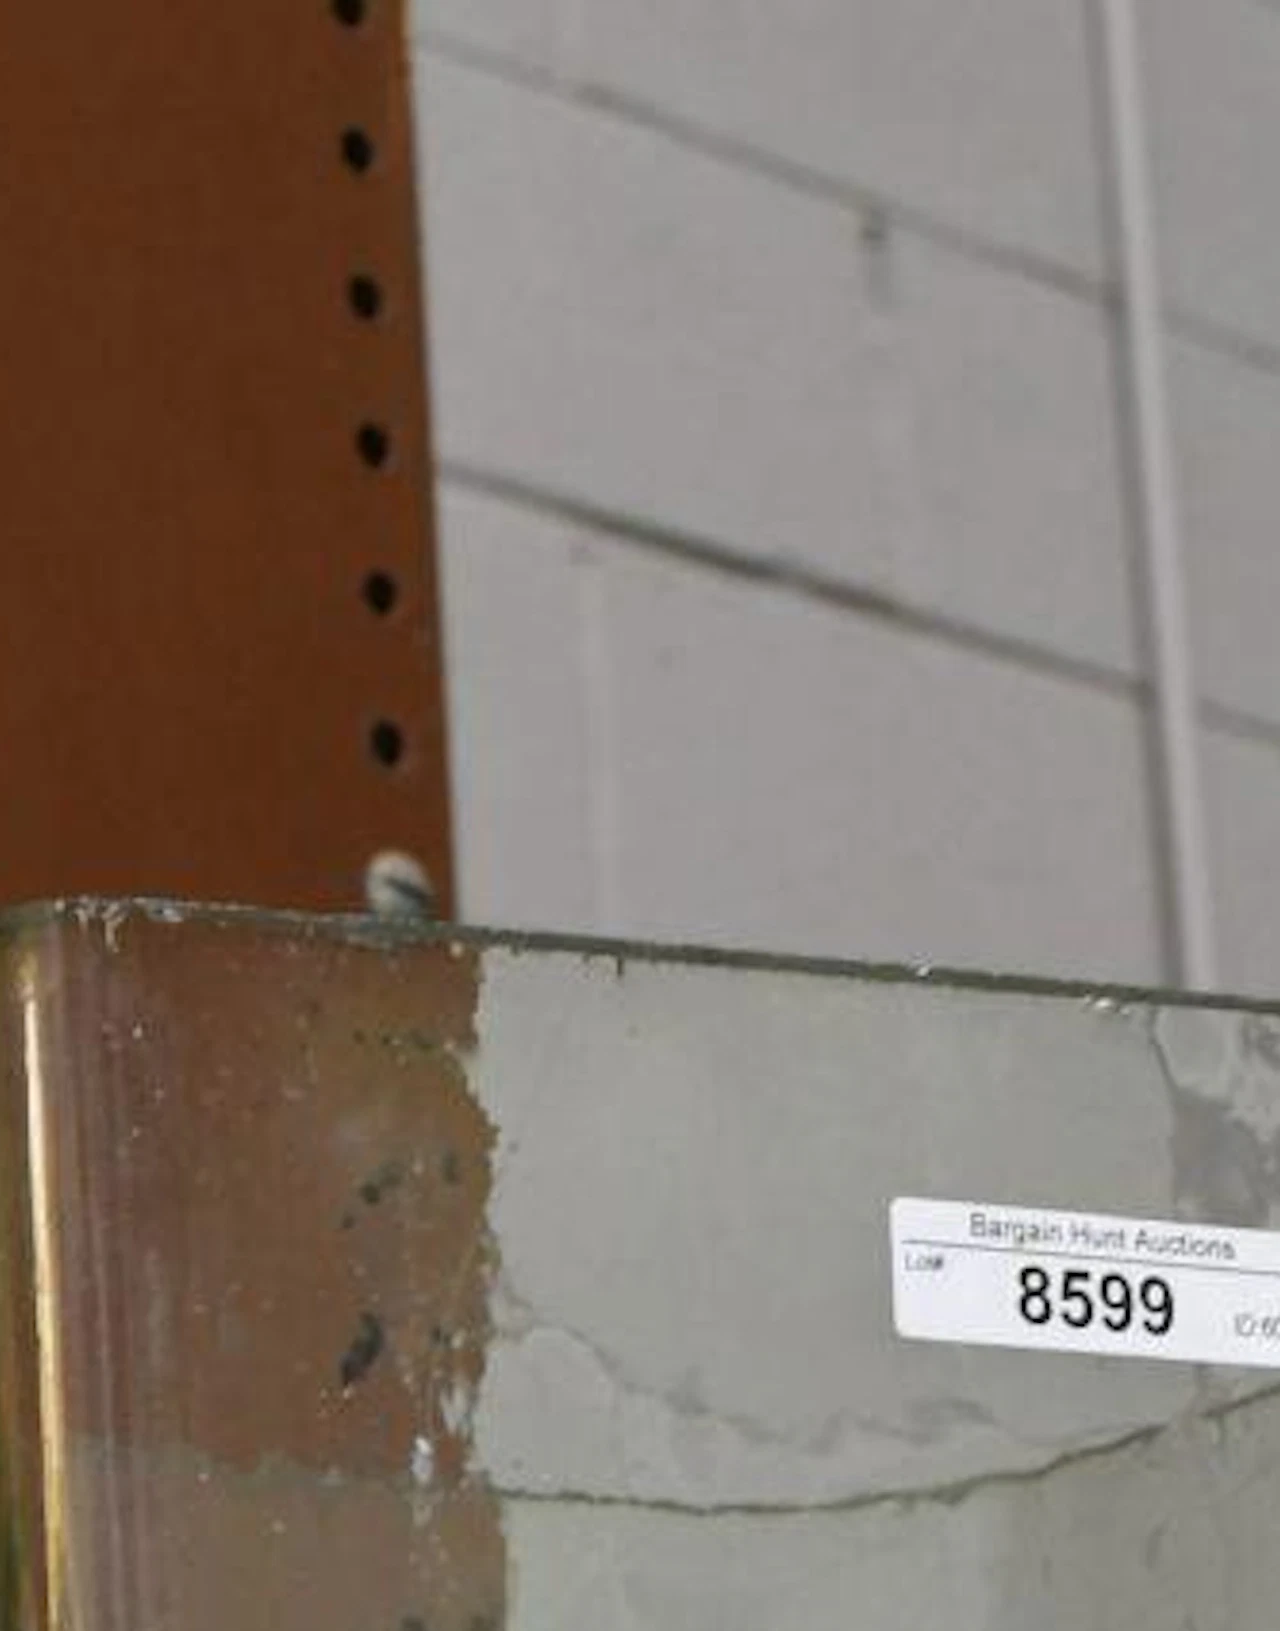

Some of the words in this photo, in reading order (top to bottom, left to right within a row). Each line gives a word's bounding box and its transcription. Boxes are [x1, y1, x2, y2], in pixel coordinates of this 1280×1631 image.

[969, 1212, 1063, 1245] Bargain
[1070, 1221, 1126, 1249] Hunt
[1134, 1227, 1237, 1260] Auctions
[1019, 1266, 1173, 1336] 8599
